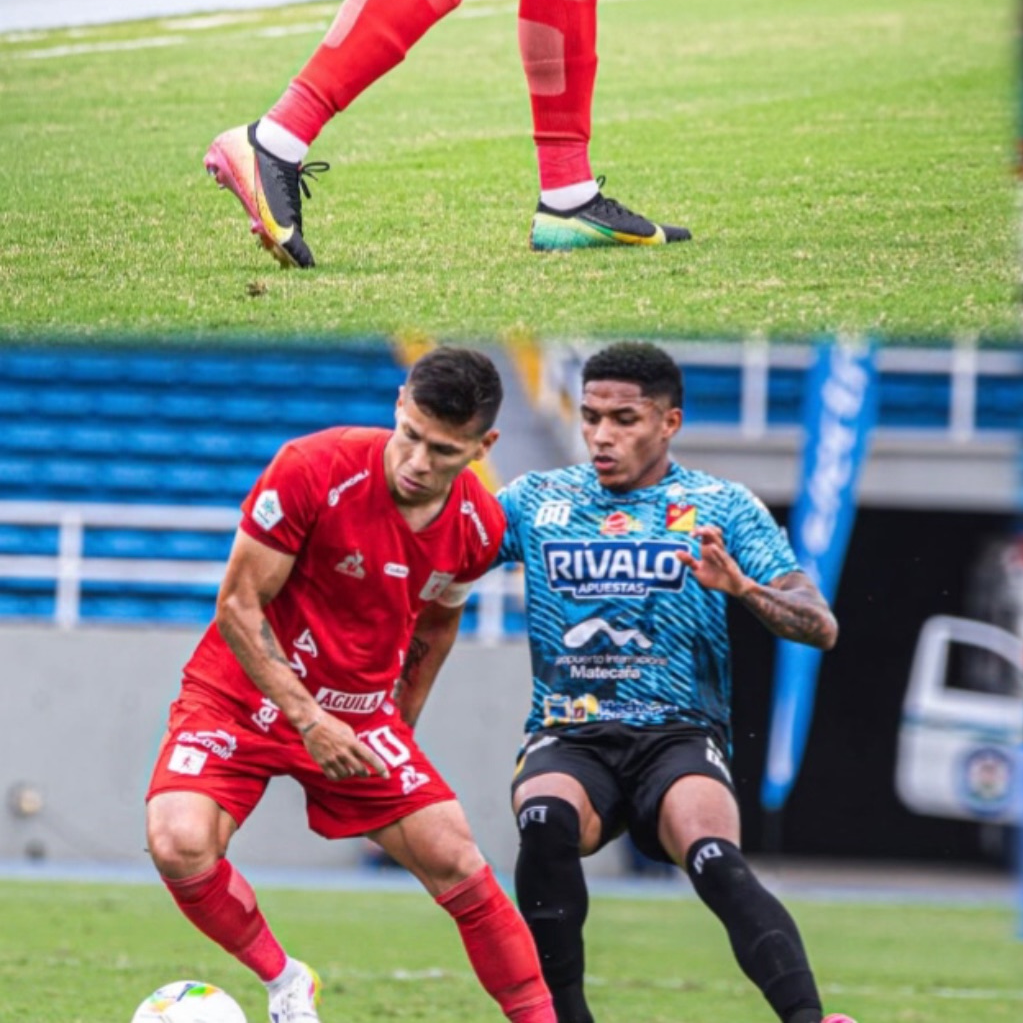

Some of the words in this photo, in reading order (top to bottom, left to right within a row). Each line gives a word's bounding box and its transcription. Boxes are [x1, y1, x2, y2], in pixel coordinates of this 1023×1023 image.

[548, 550, 681, 581] RIVALO
[577, 581, 646, 596] APUESTAS
[319, 693, 380, 711] AGUILA
